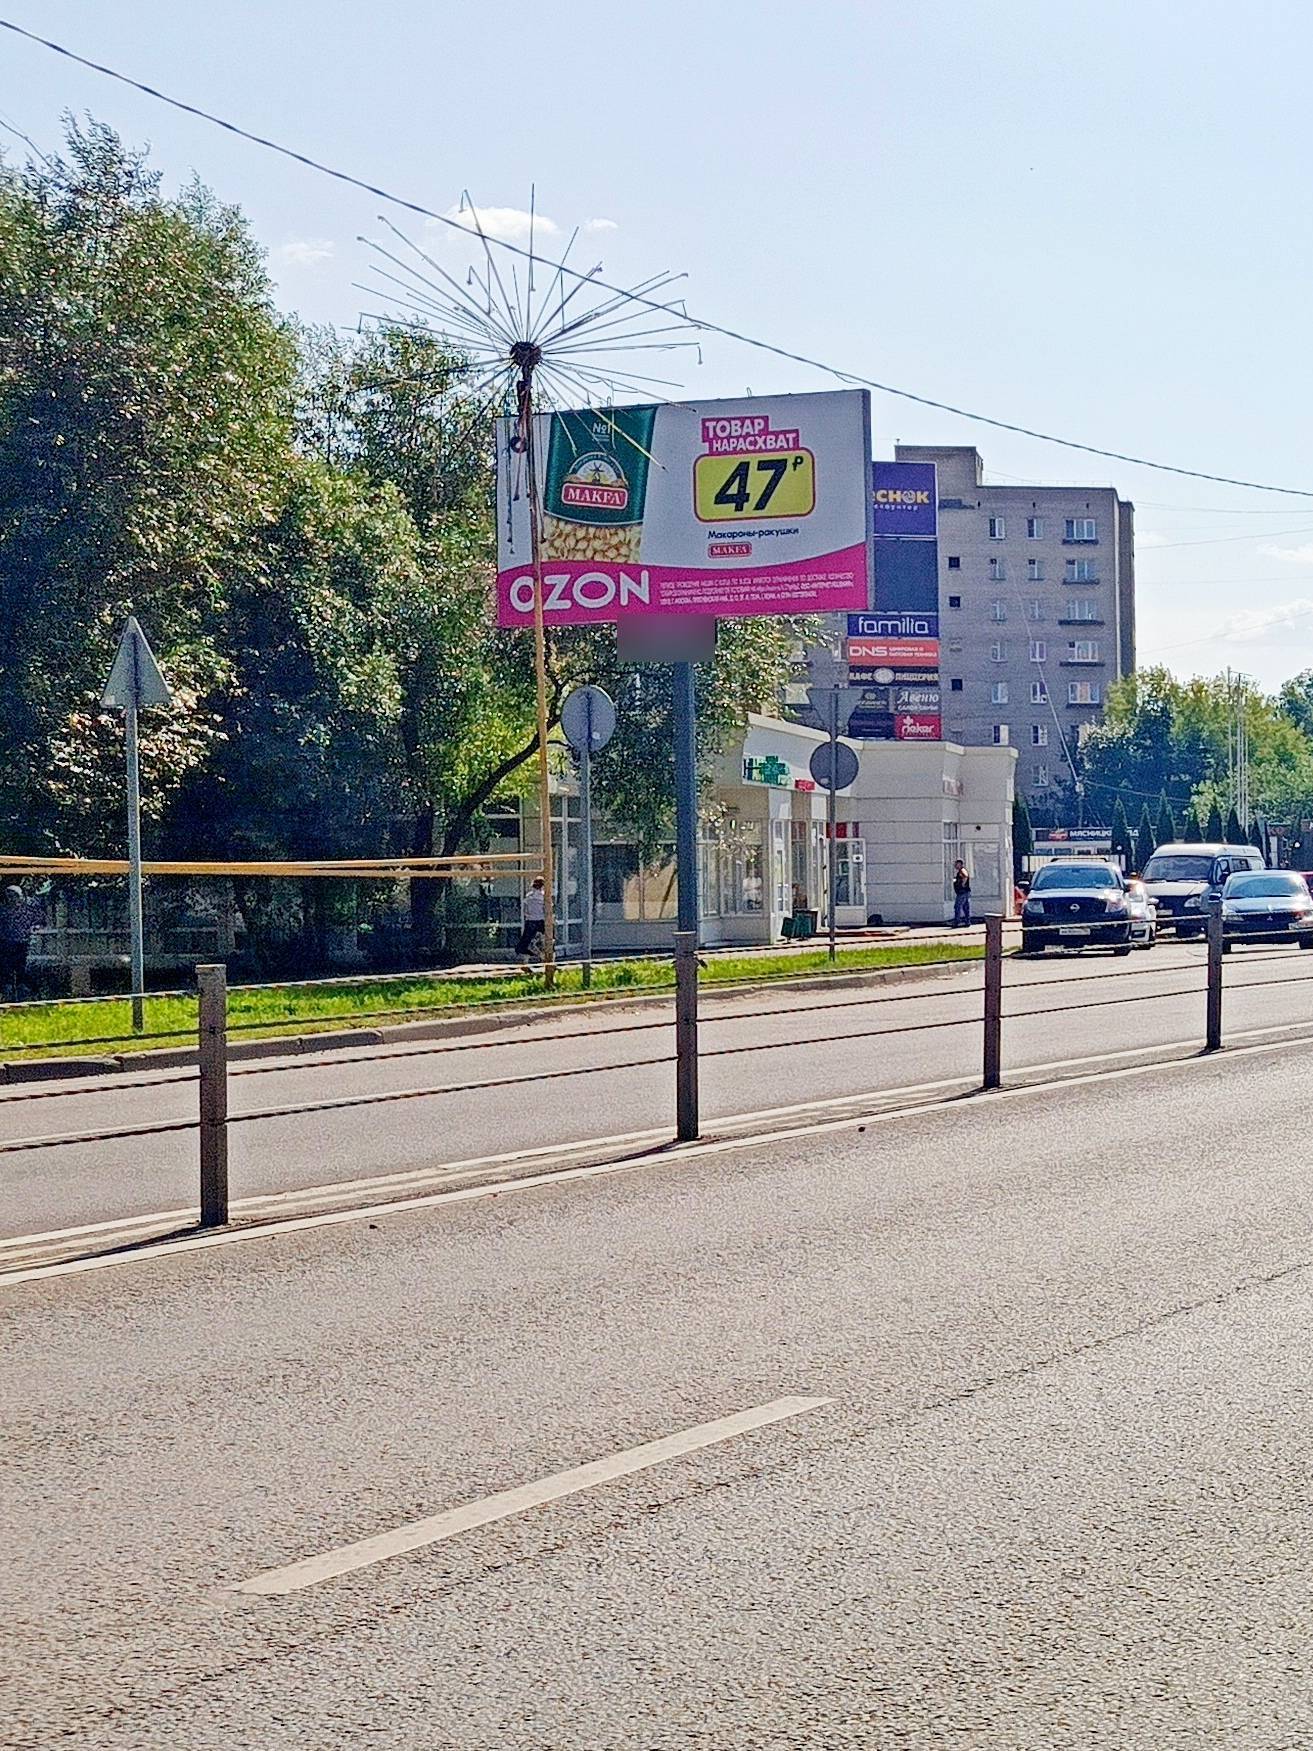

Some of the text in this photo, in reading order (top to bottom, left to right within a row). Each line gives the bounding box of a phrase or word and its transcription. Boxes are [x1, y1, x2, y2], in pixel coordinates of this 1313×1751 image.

[705, 419, 765, 438] ТОВАР
[713, 433, 797, 451] НАРАСХВАТ
[714, 458, 788, 512] 47
[708, 527, 799, 540] Макароны-ракушки
[510, 570, 650, 613] OZON
[858, 616, 929, 634] familia
[849, 646, 888, 657] DNS
